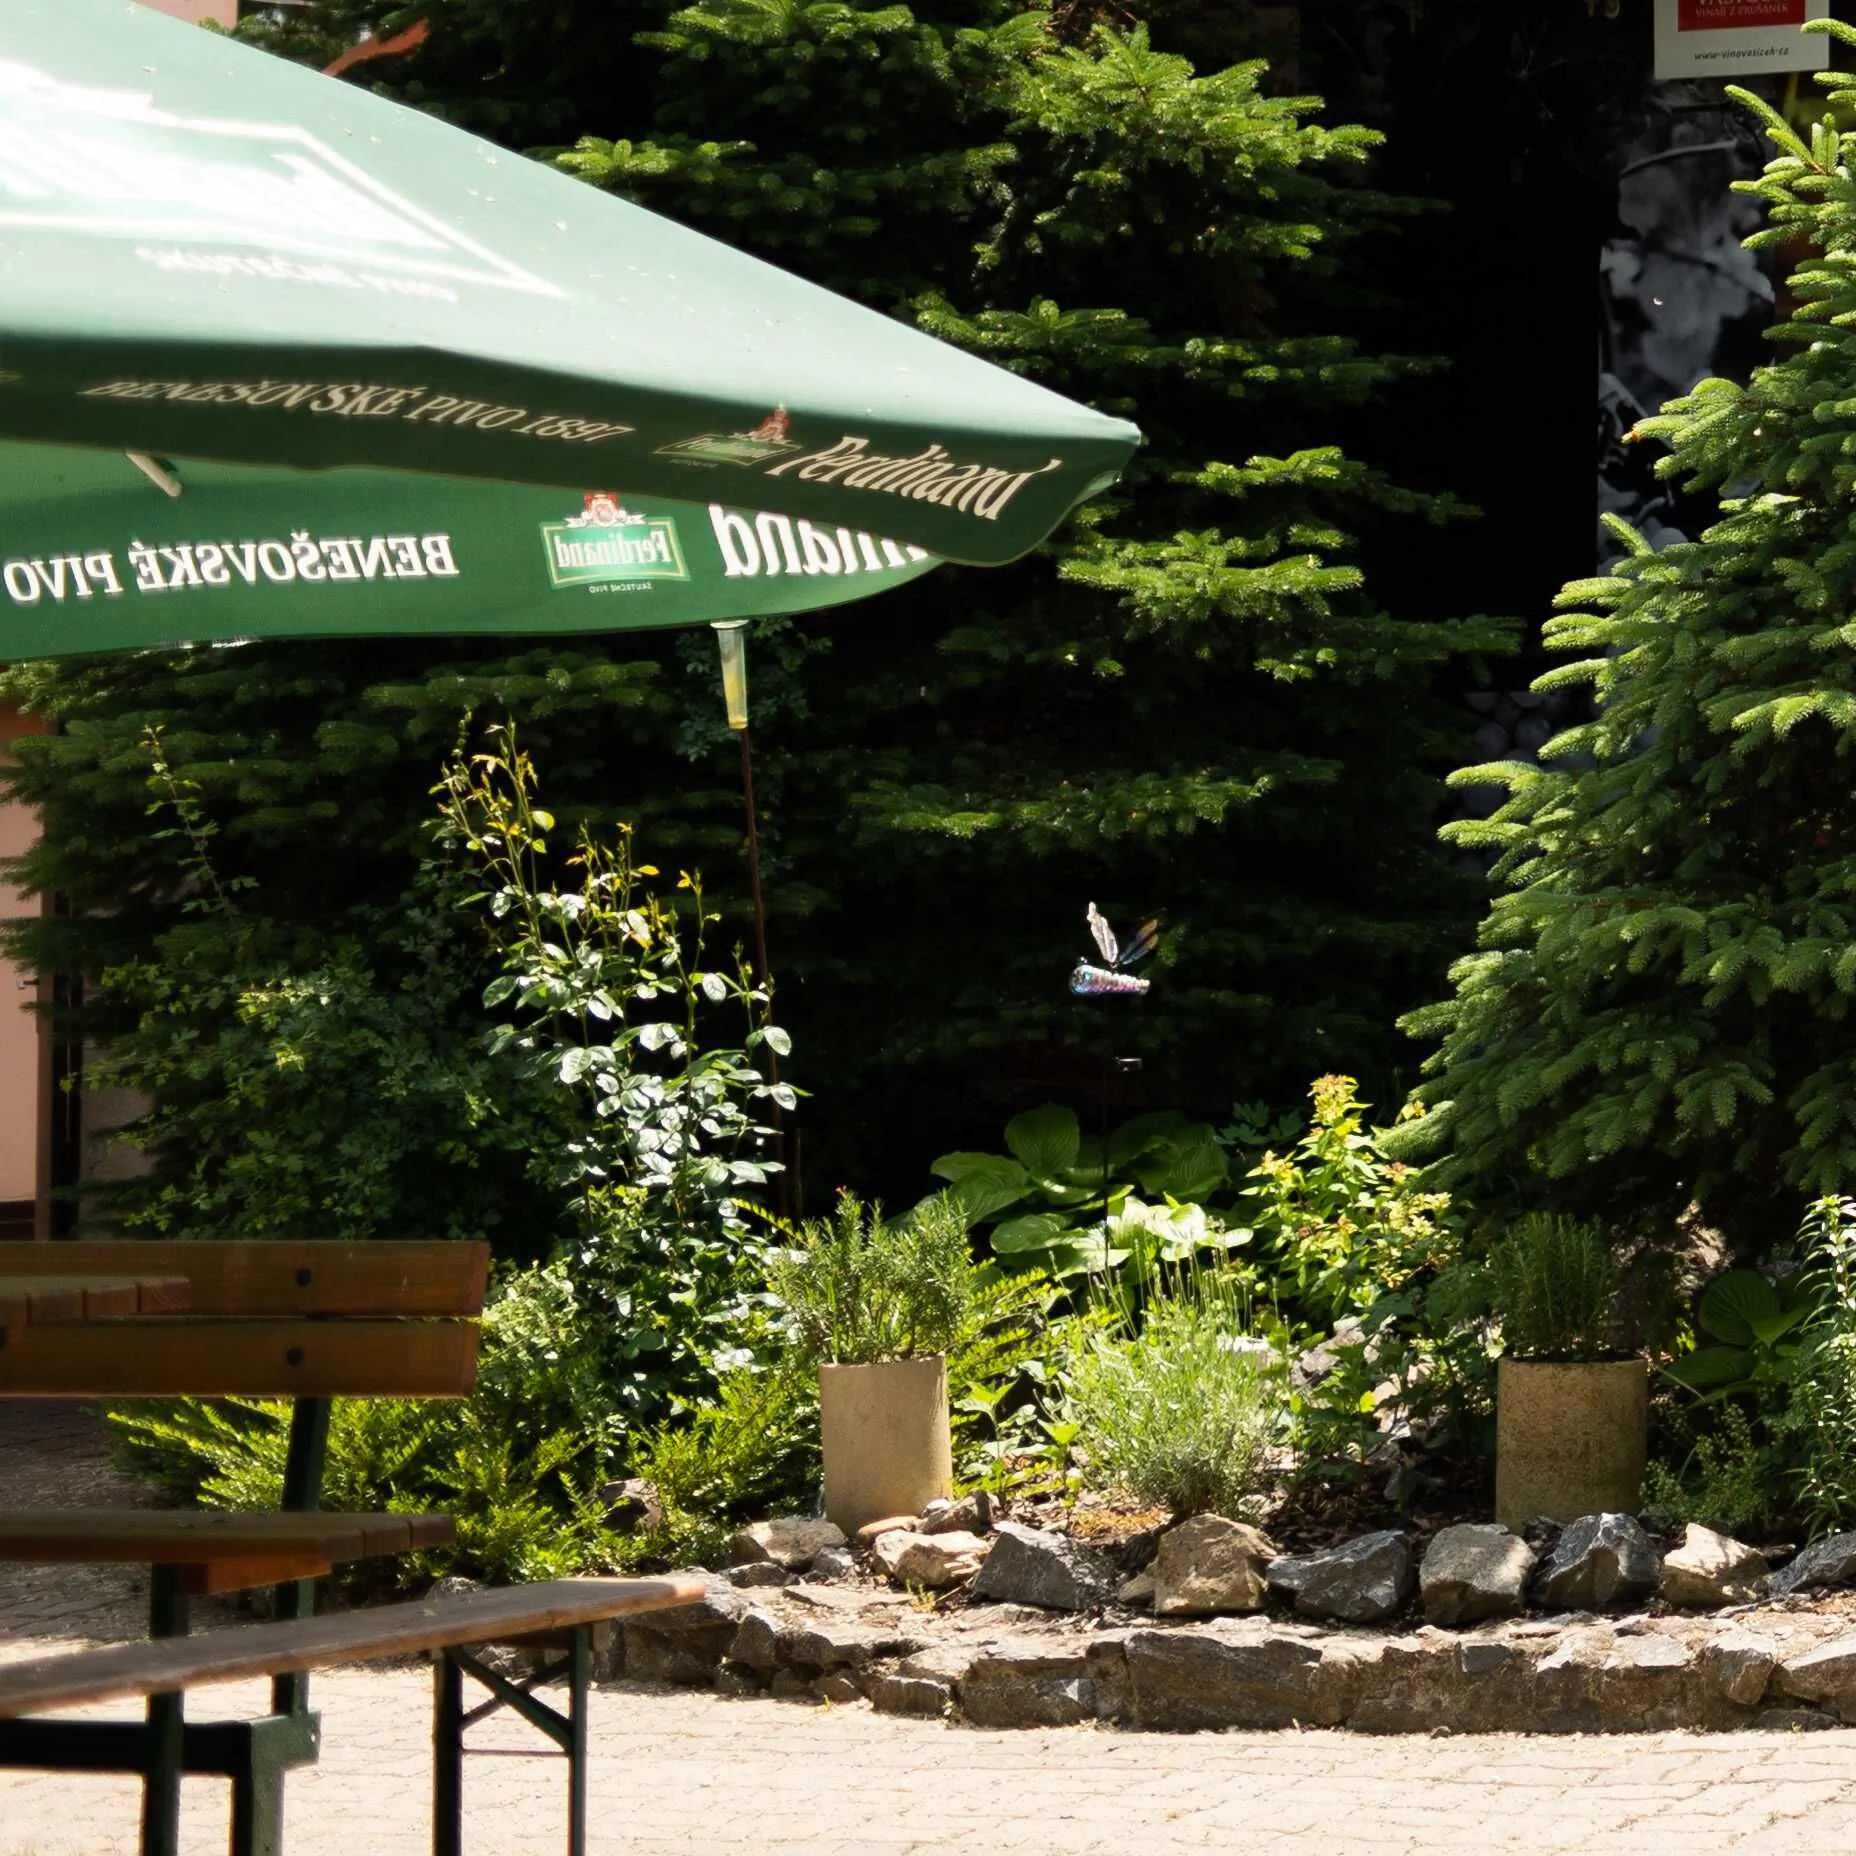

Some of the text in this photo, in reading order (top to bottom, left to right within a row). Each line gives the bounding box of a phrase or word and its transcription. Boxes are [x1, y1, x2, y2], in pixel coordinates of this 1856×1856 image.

[77, 379, 636, 443] BENEŠOVSKÉ PIVO 1897
[764, 436, 1063, 522] Ferdinand
